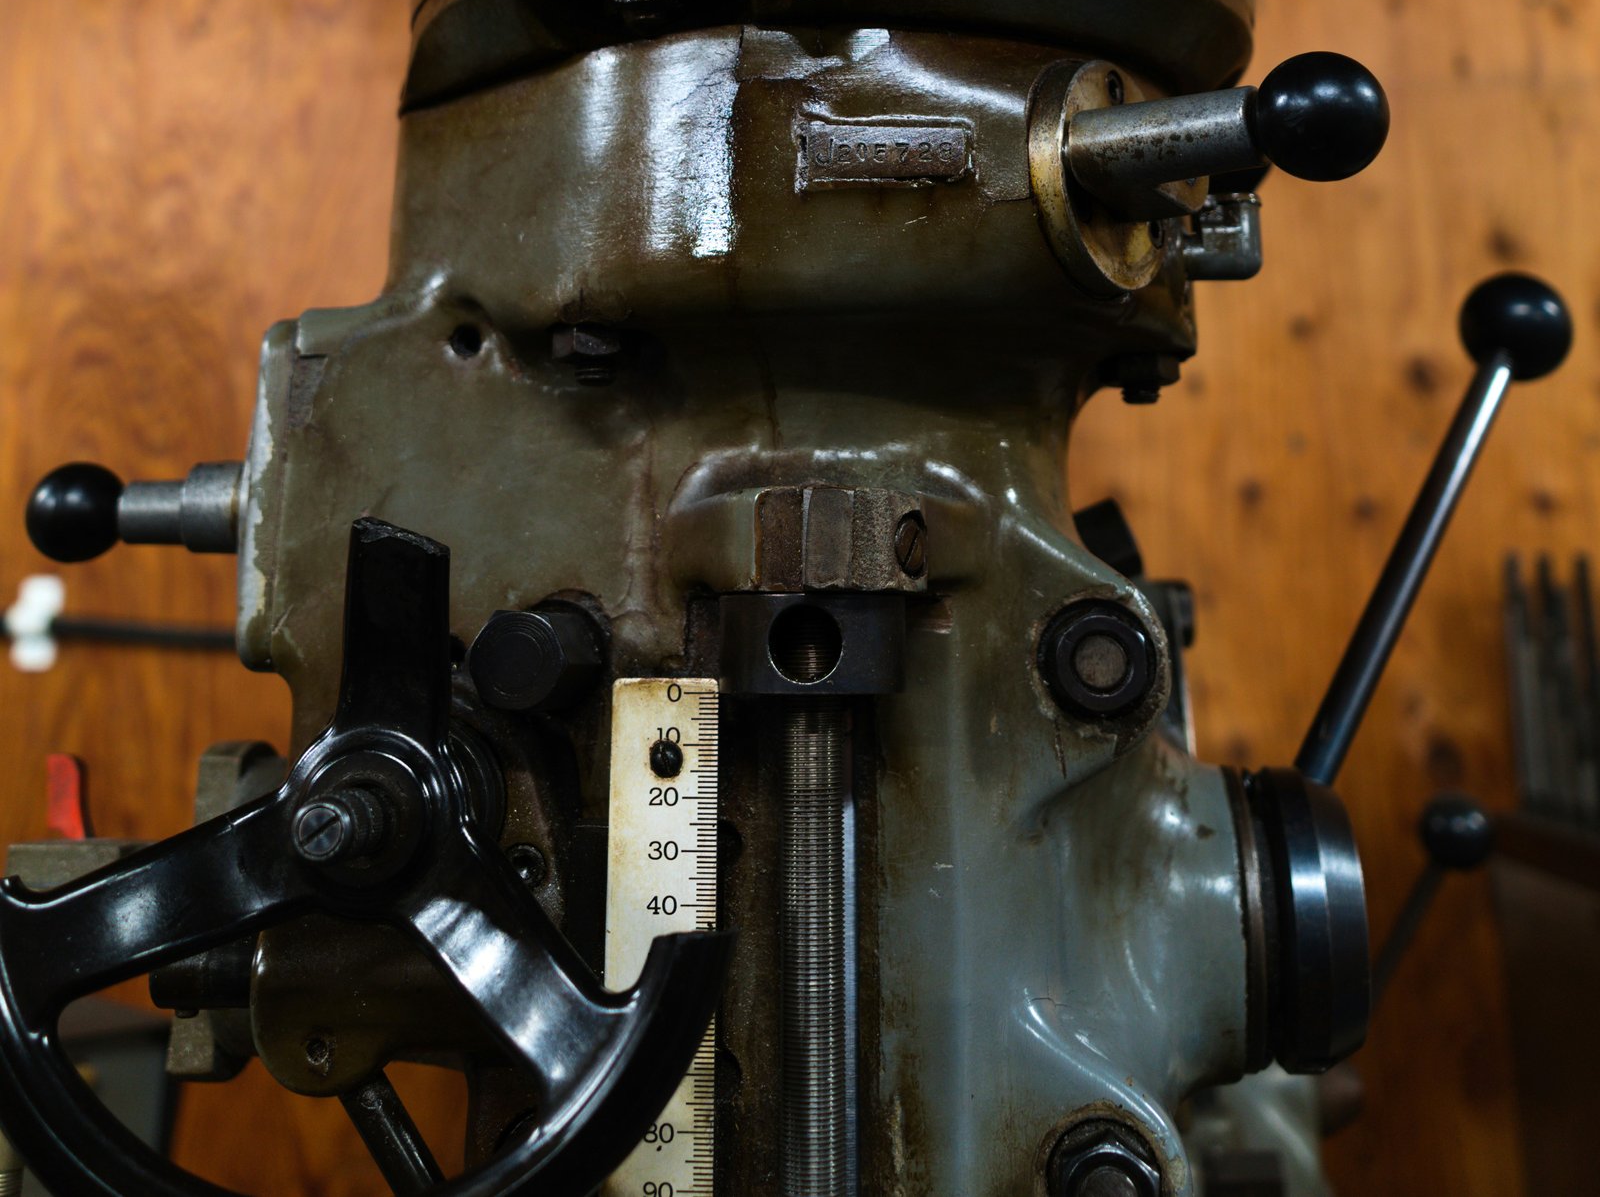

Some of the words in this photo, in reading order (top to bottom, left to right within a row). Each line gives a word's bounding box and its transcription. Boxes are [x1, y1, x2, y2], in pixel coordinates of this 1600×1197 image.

[667, 683, 682, 703] 0
[648, 787, 679, 807] 20
[648, 841, 679, 861] 30
[646, 895, 677, 915] 40
[643, 1181, 673, 1197] 90
